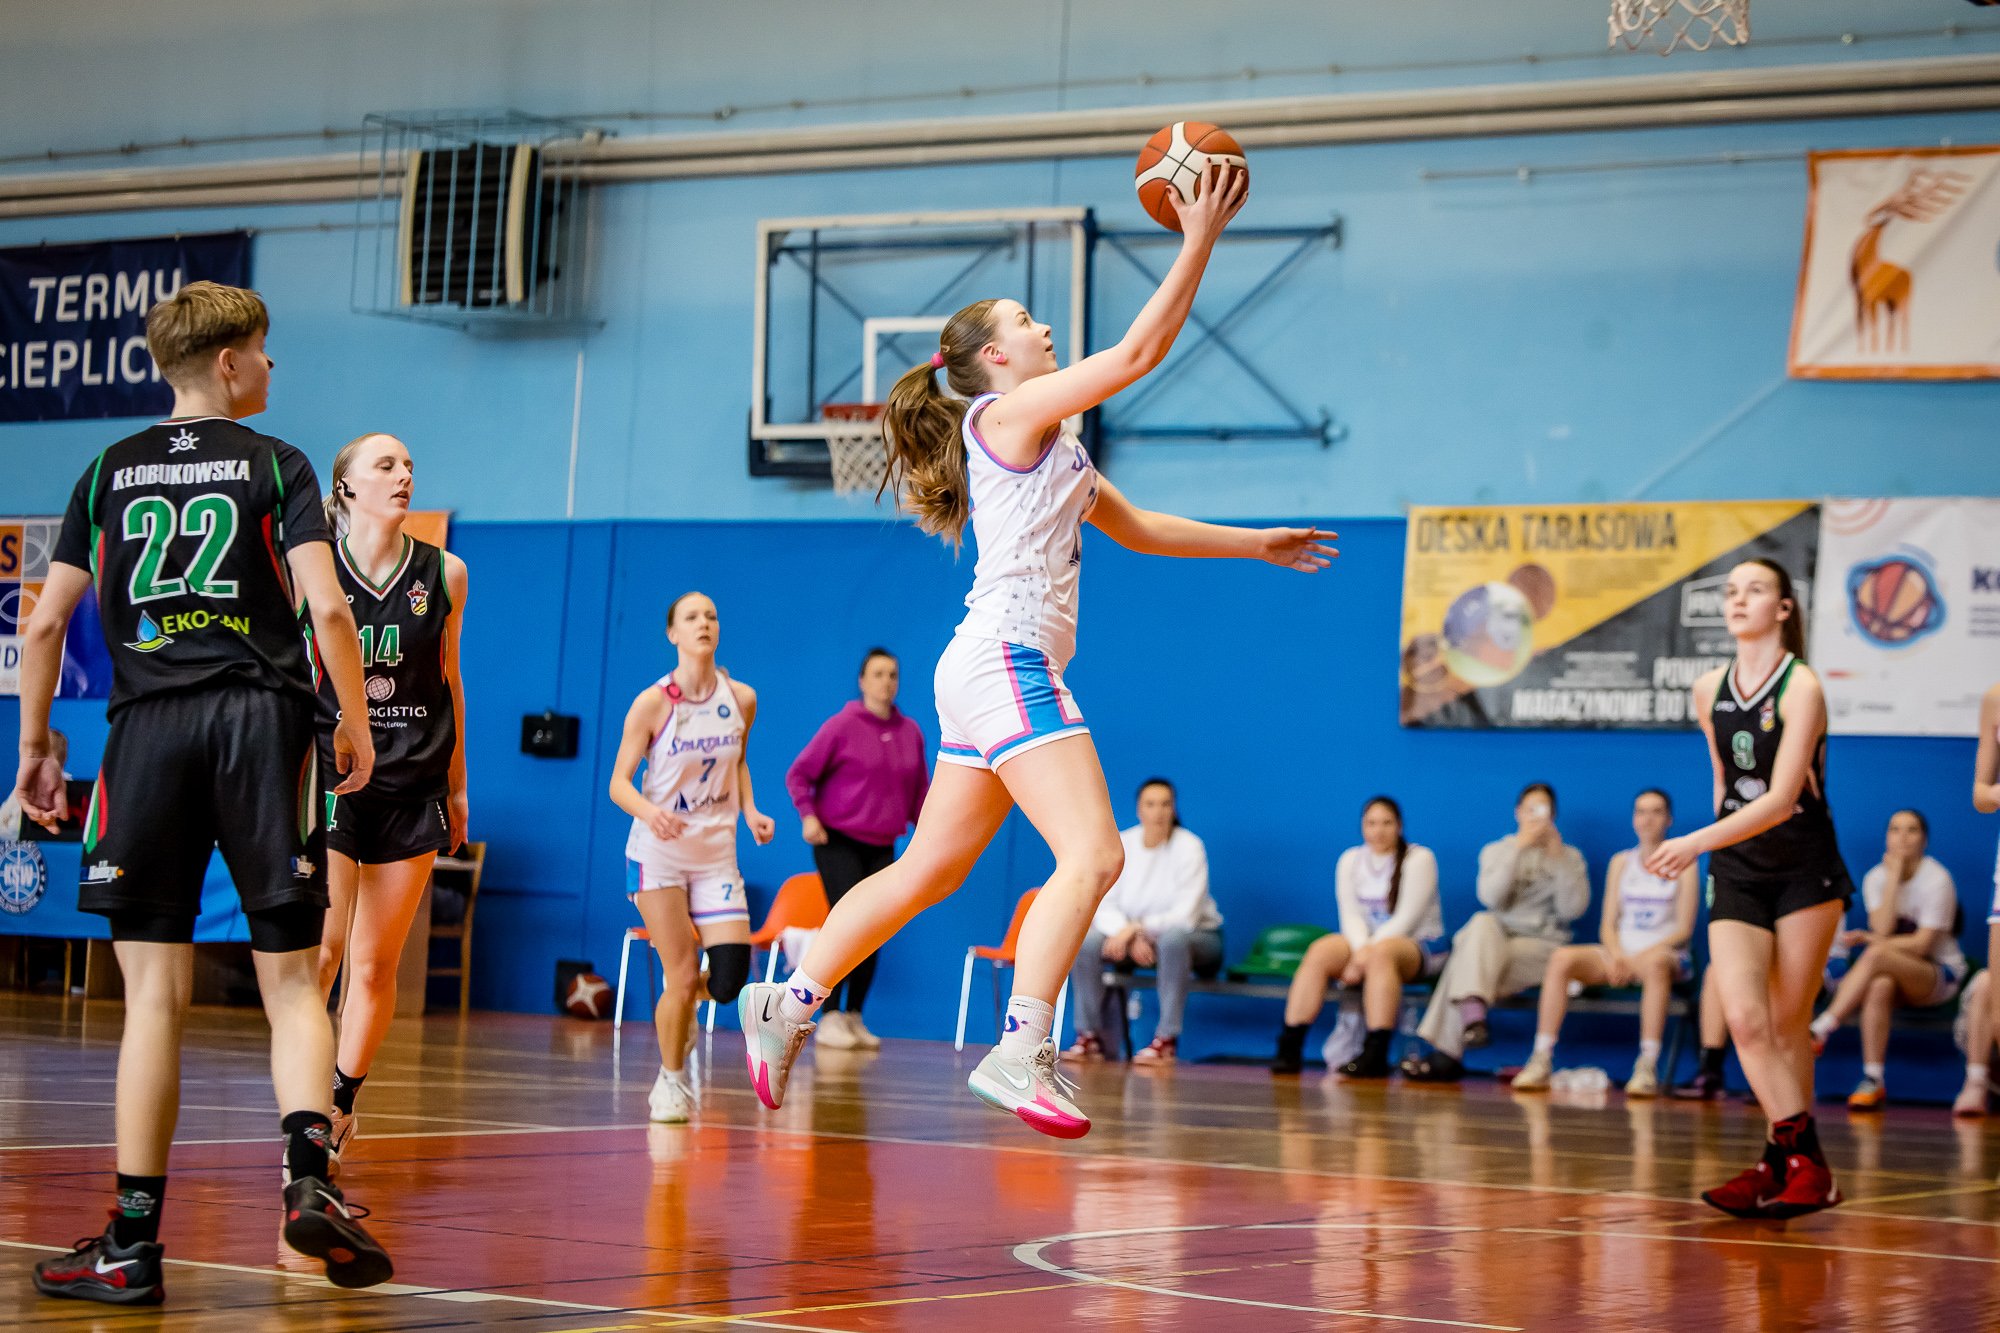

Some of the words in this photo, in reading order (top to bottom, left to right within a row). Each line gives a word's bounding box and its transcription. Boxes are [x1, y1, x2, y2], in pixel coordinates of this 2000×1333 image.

[0, 335, 162, 389] IEPLIC
[113, 460, 250, 491] KŁOBUKOWSKA
[123, 493, 239, 605] 22
[1417, 514, 1509, 553] DESKA
[1522, 510, 1678, 551] TARASOWA
[358, 624, 403, 667] 14
[367, 705, 428, 718] OGISTICS
[1732, 730, 1757, 770] 9
[700, 757, 717, 784] 7
[721, 883, 733, 901] 7
